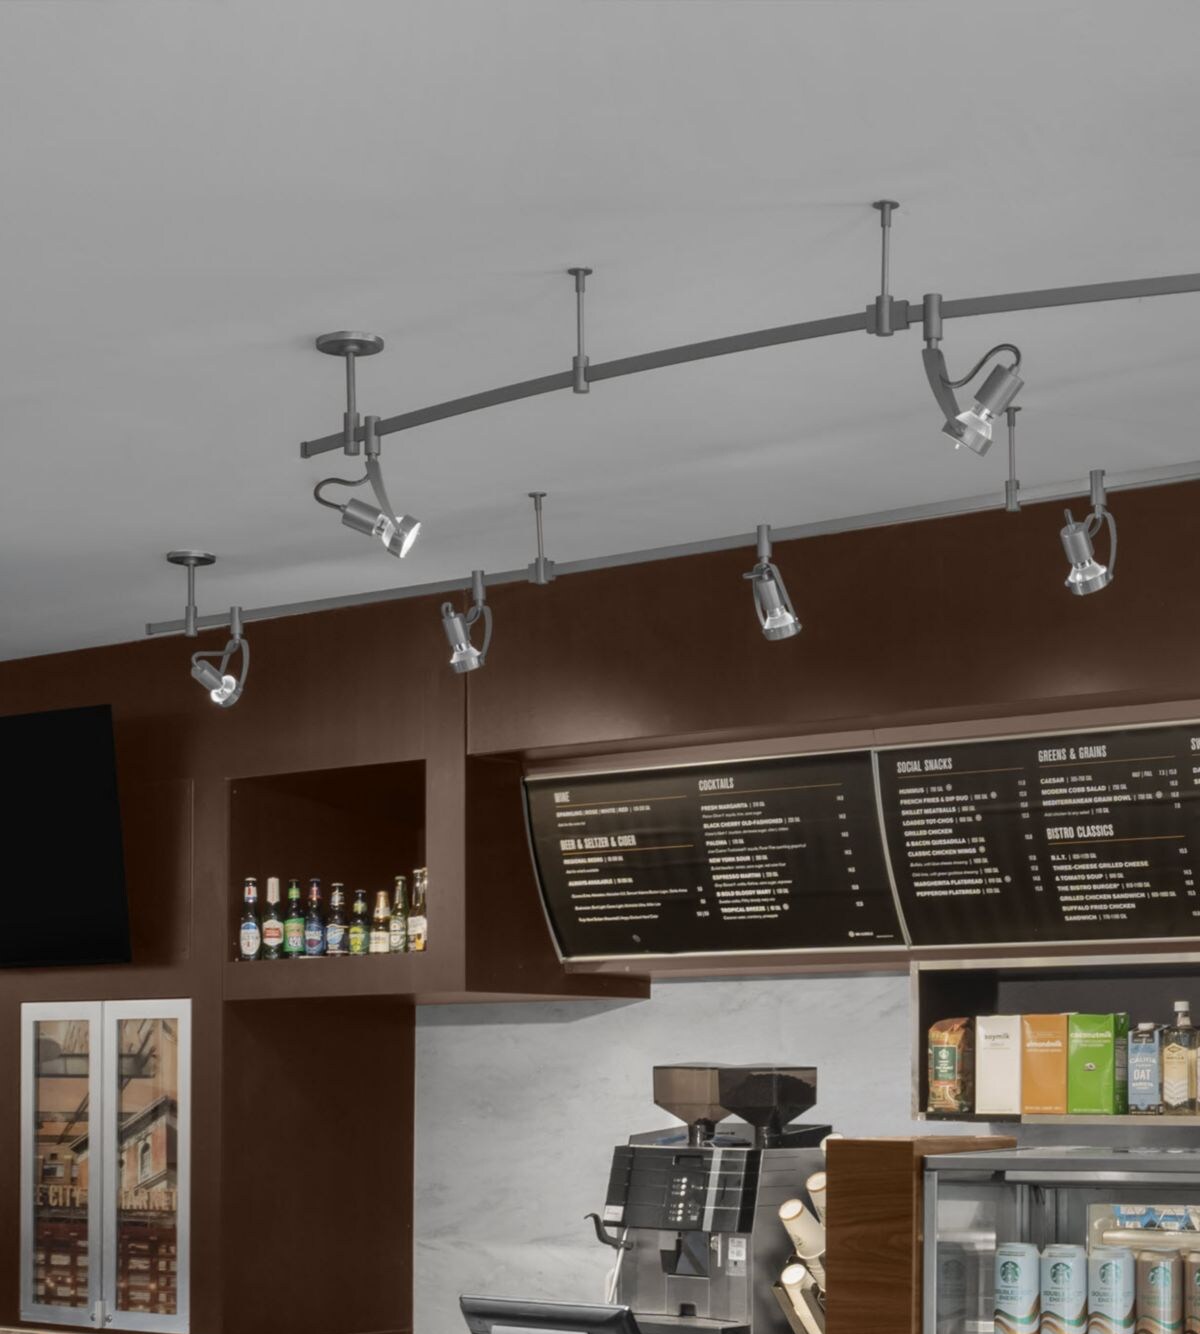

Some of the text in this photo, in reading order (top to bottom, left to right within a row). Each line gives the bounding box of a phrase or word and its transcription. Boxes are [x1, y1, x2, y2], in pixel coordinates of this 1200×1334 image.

[1038, 745, 1108, 763] GREENS & GRAINS
[896, 757, 953, 774] SOCIAL SNACKS
[698, 777, 735, 791] COCKTAILS
[1040, 777, 1065, 785] CAESAR
[1041, 788, 1067, 796] MODERN
[1068, 786, 1085, 794] COBB
[1086, 785, 1107, 793] SALAD
[1093, 796, 1113, 804] GRAIN
[1113, 794, 1133, 803] BOWL
[701, 804, 718, 812] FRESH
[923, 806, 957, 815] MEATBALLS
[720, 820, 741, 828] CHERRY
[927, 828, 953, 836] CHICKEN
[1046, 824, 1114, 840] BISTRO CLASSICS
[907, 850, 931, 858] CLASSIC
[931, 848, 957, 857] CHICKEN
[1098, 861, 1124, 869] GRILLED
[1124, 860, 1150, 868] CHEESE
[1060, 874, 1086, 882] TOMATO
[1070, 884, 1093, 892] BISTRO
[1112, 892, 1145, 900] SANDWICH
[1090, 903, 1108, 911] FRIED
[1064, 914, 1097, 922] SANDWICH
[984, 1033, 1010, 1041] soymilk
[1133, 1069, 1152, 1080] OAT
[48, 1184, 81, 1207] CITY
